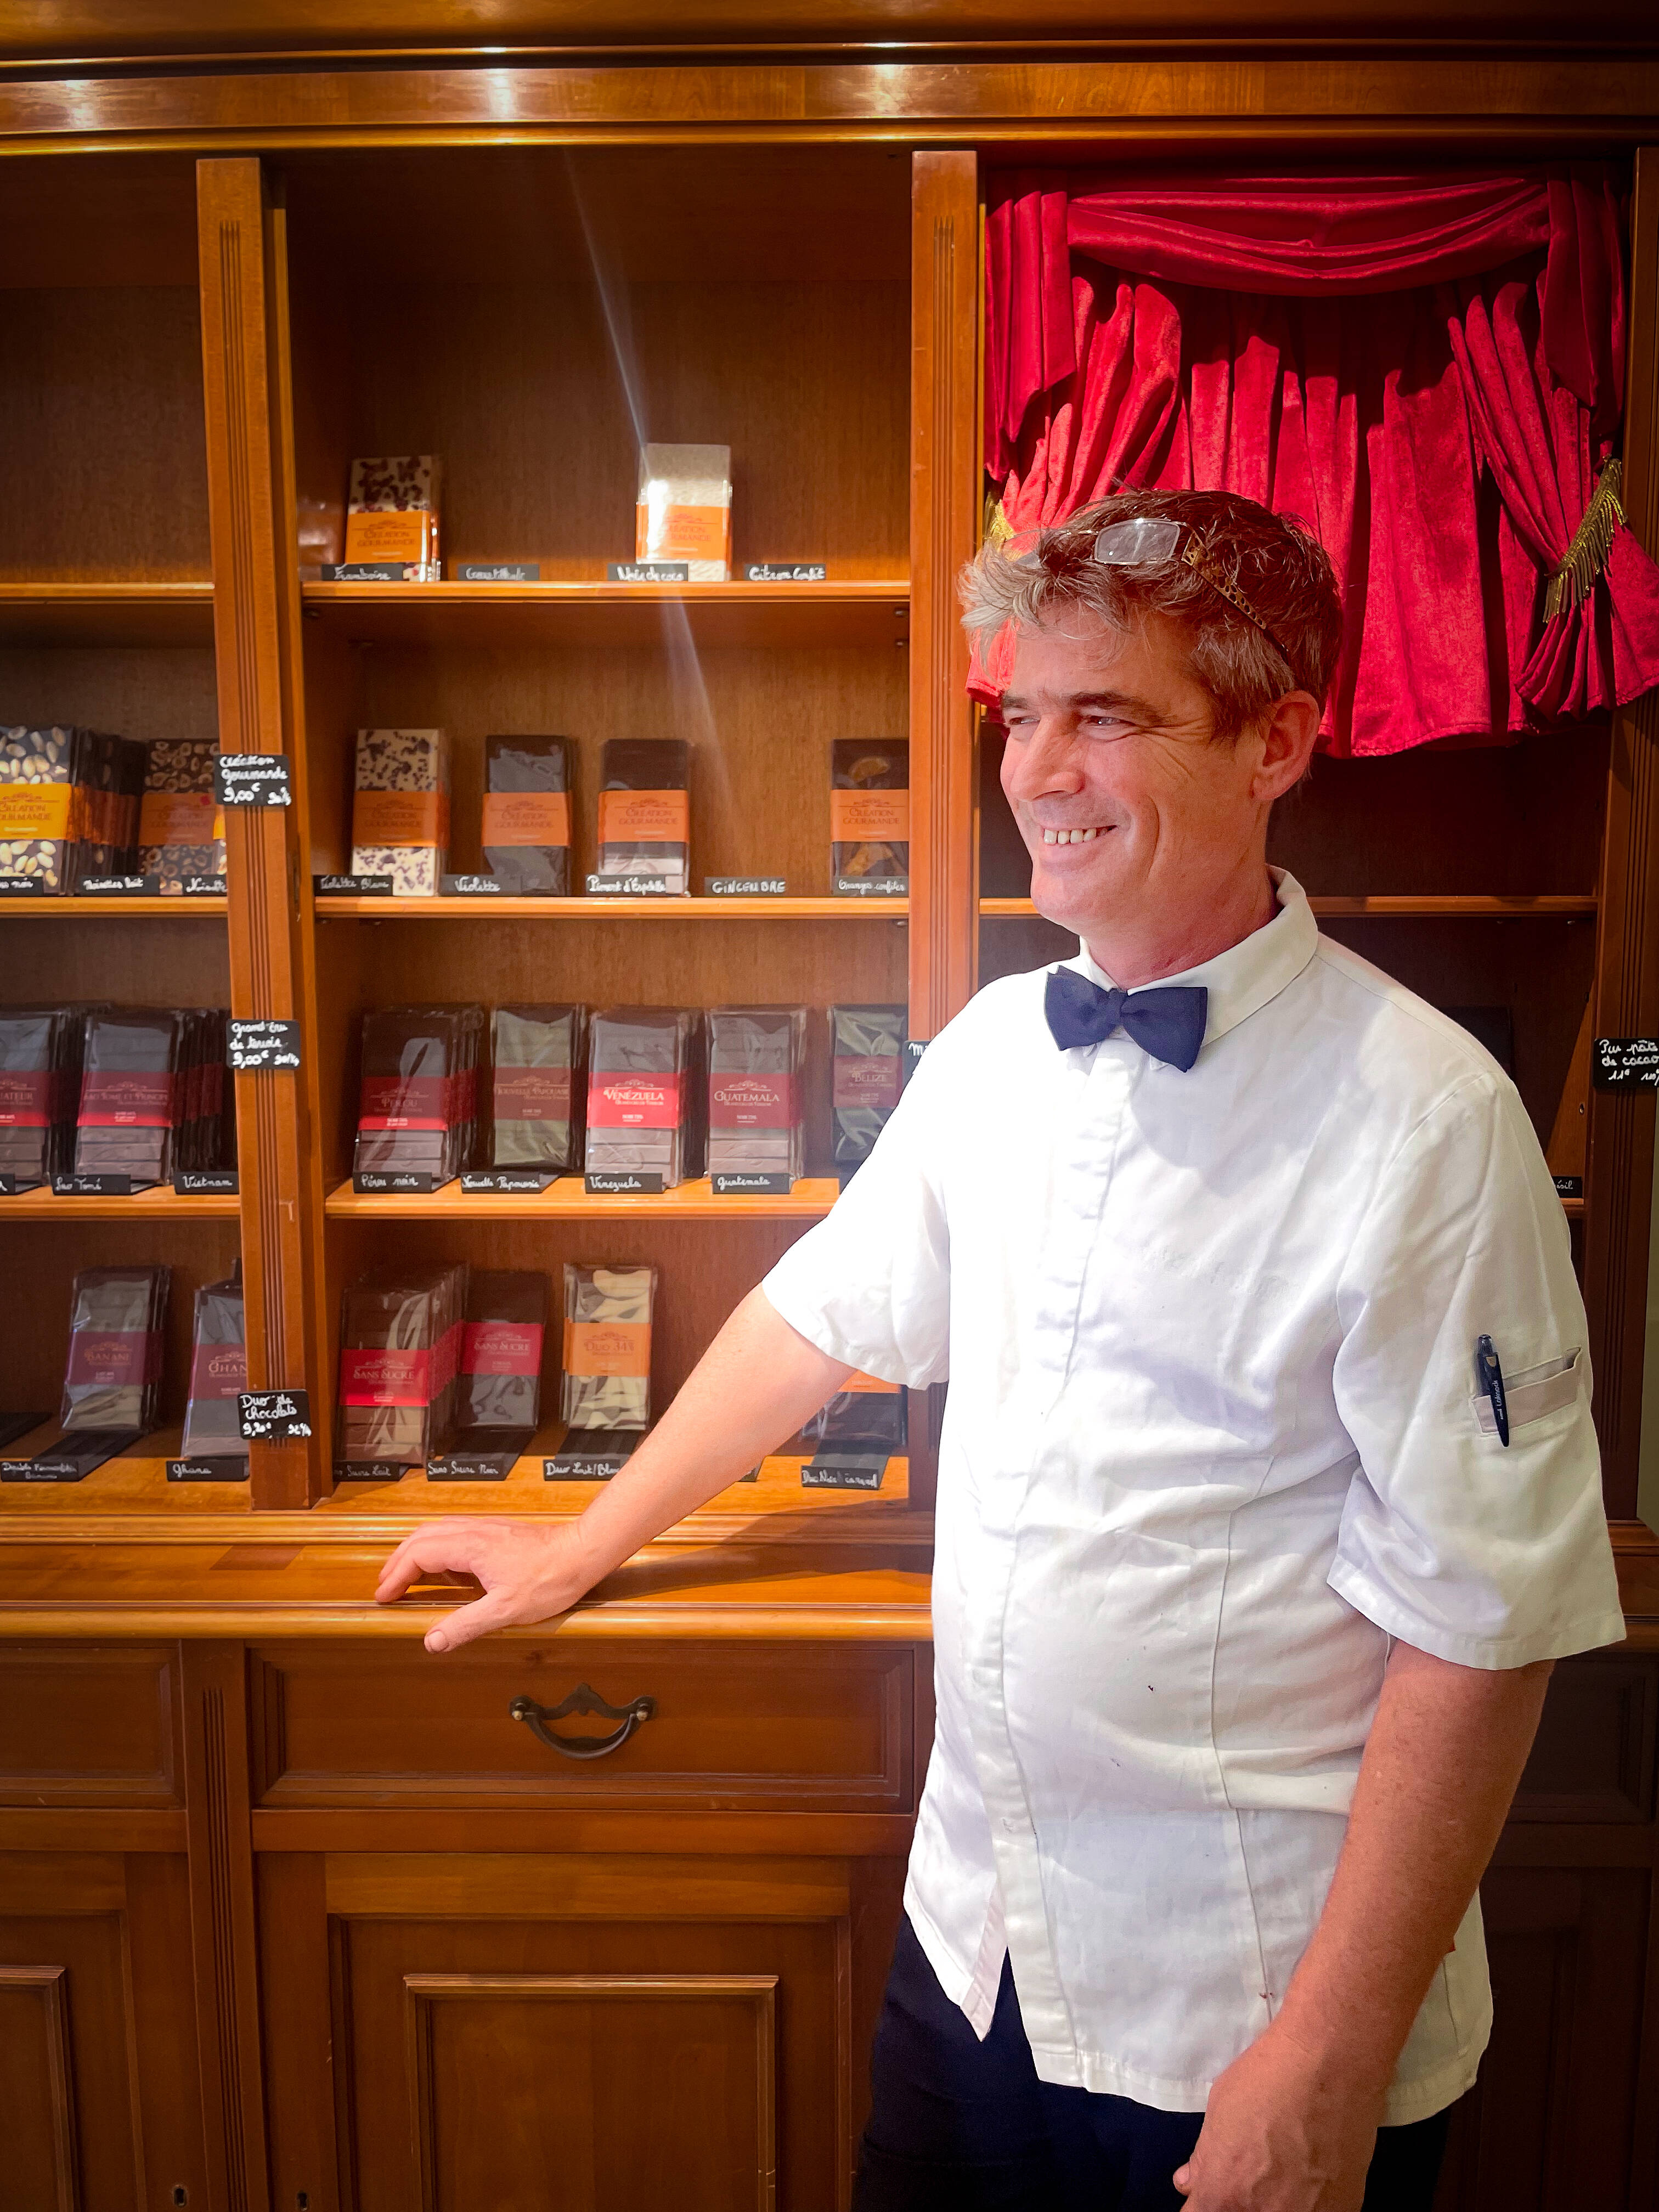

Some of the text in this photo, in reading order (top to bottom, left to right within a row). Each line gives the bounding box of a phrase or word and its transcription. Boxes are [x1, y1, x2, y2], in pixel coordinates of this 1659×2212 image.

[1601, 1055, 1617, 1066] de
[603, 1088, 664, 1100] VÉNÉZUELA
[714, 1090, 780, 1102] GUATEMALA
[182, 1175, 233, 1189] Vietnam
[589, 1176, 642, 1192] Venezuela
[239, 1394, 270, 1408] Duo
[245, 1403, 297, 1420] chocolats
[545, 1462, 571, 1476] Duo
